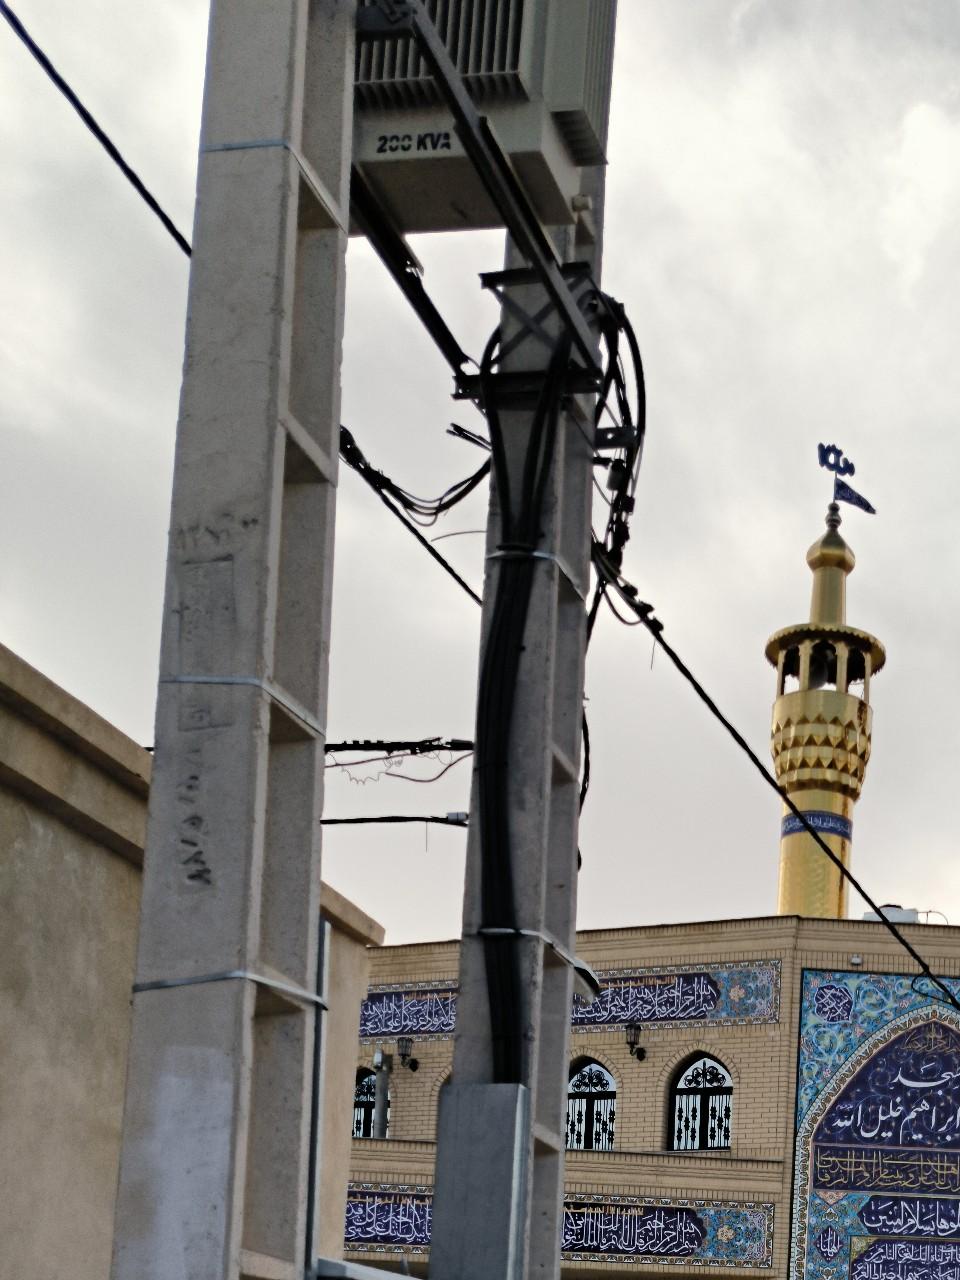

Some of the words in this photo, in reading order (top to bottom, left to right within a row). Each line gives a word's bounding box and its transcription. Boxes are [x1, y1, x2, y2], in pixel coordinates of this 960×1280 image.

[376, 134, 412, 153] 200
[417, 132, 451, 151] KVA
[832, 1103, 862, 1127] الله
[860, 1097, 904, 1138] خلیل
[900, 1099, 960, 1145] ابراهیم
